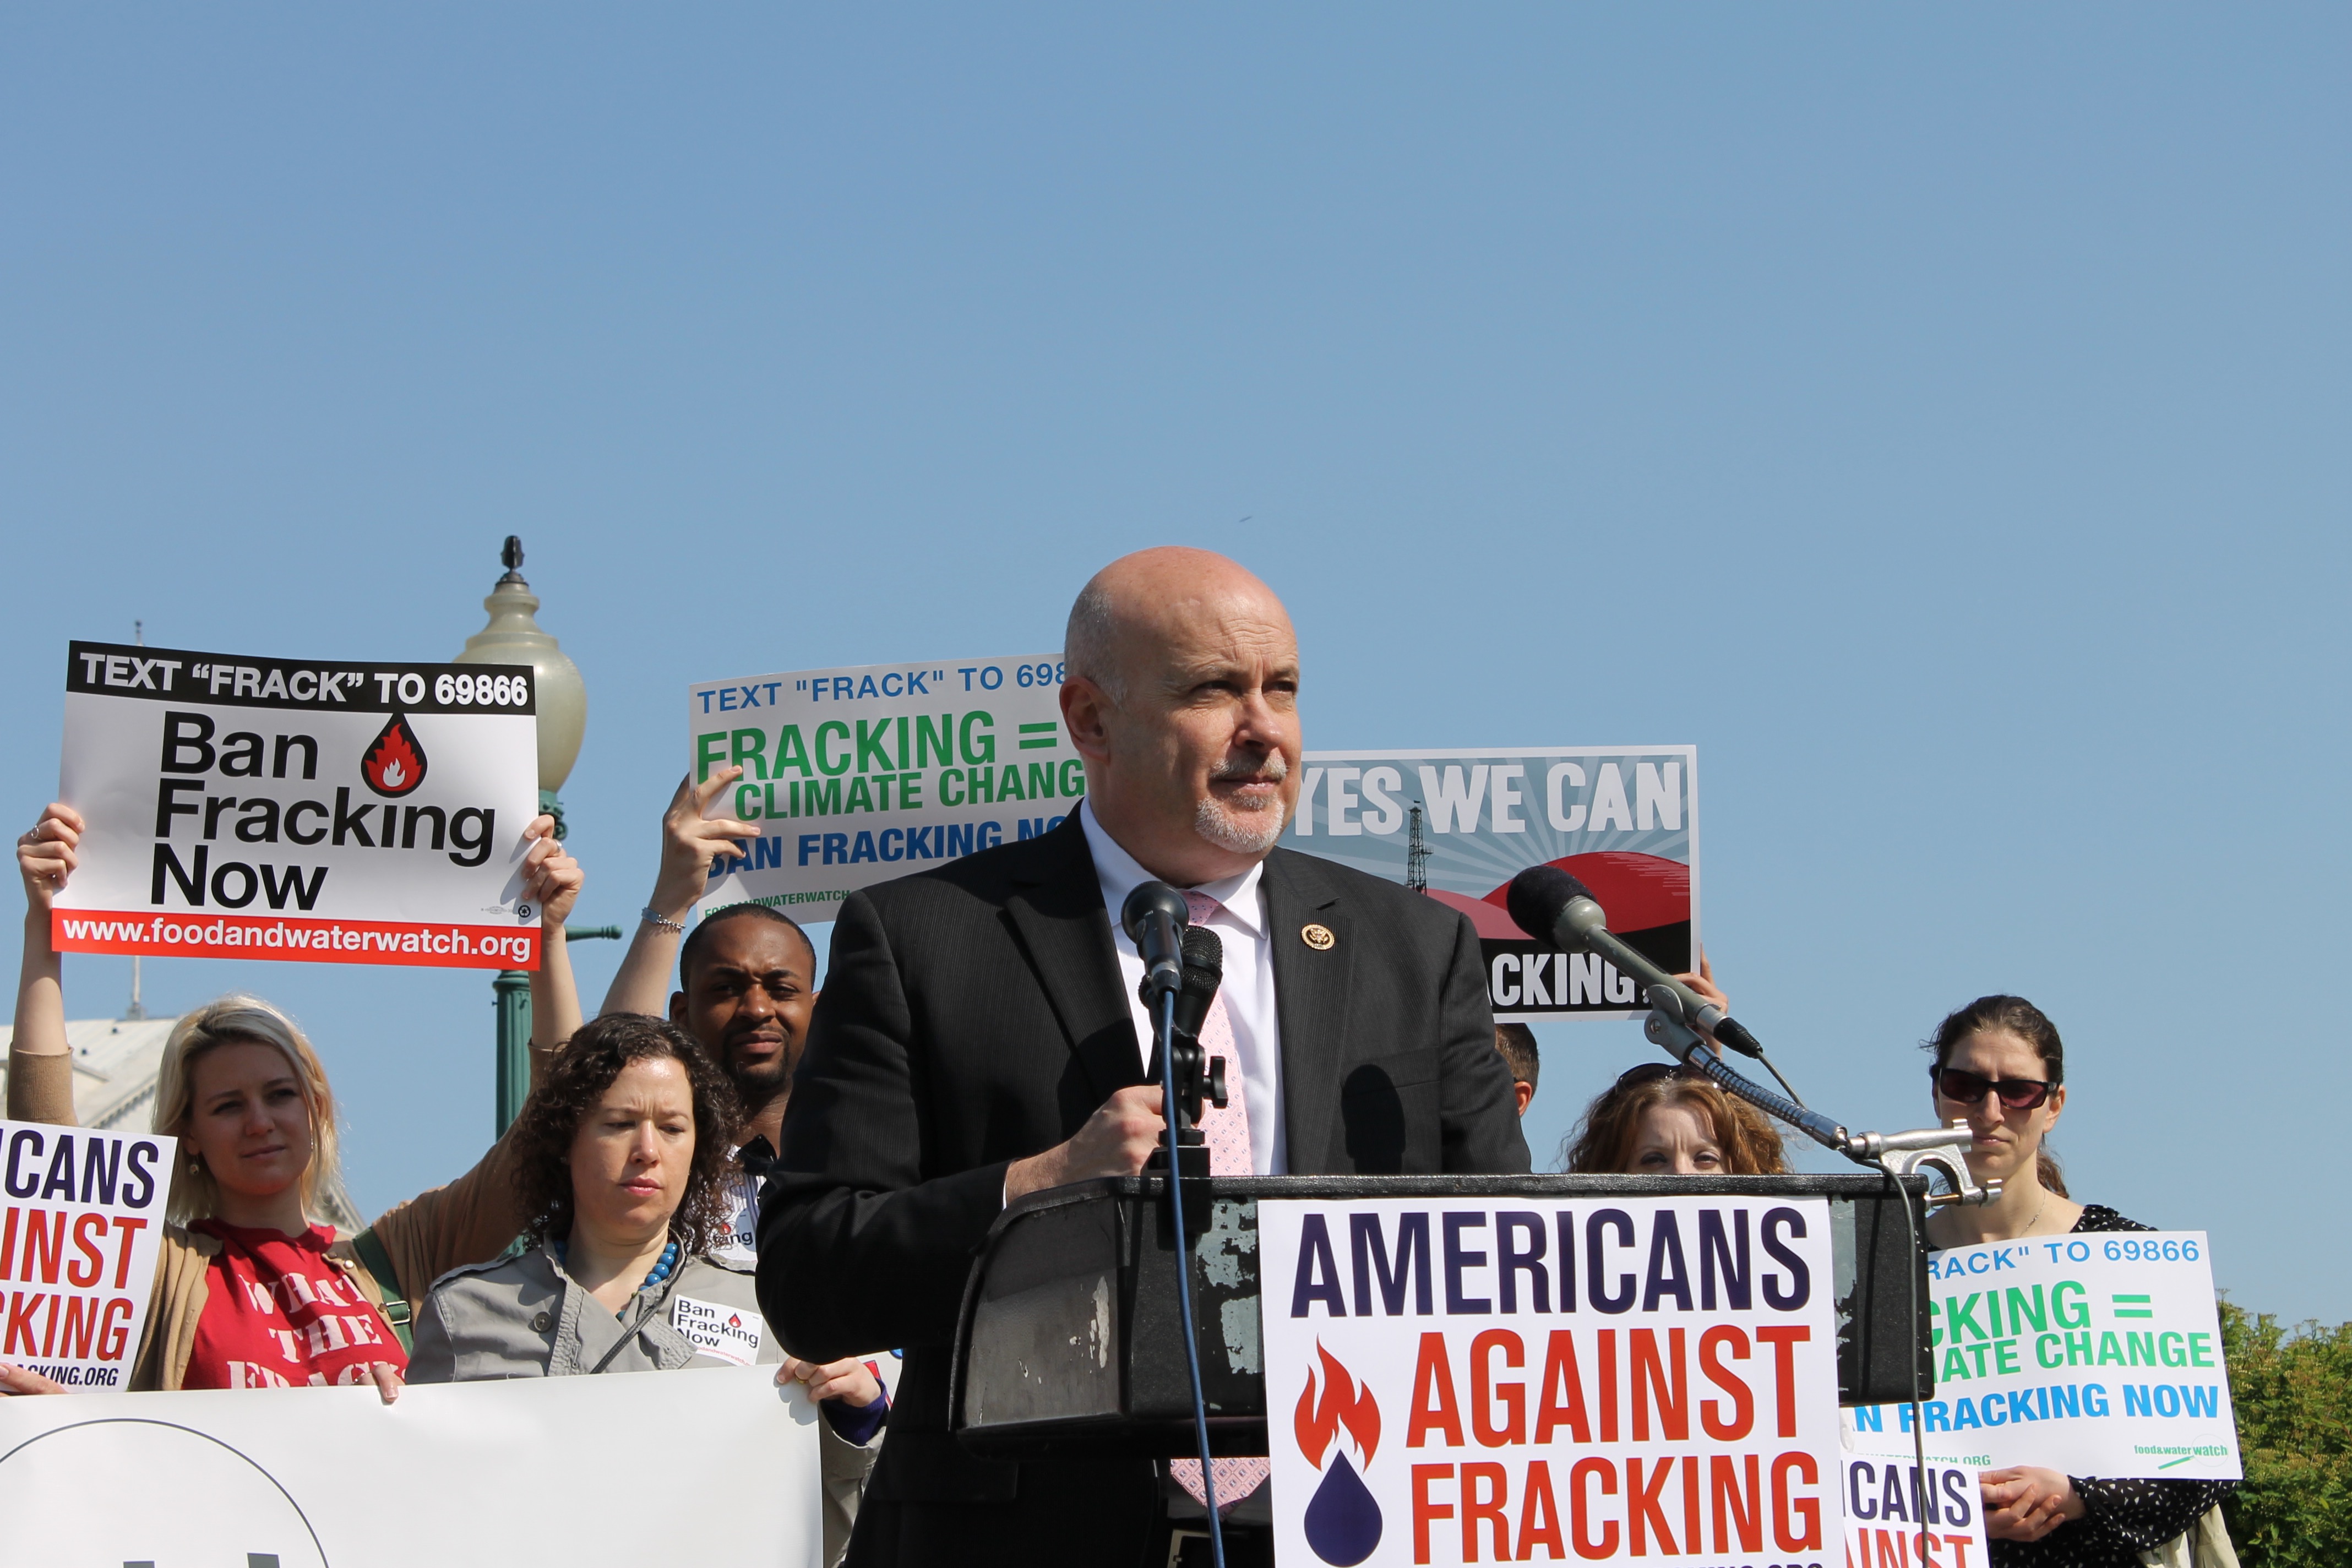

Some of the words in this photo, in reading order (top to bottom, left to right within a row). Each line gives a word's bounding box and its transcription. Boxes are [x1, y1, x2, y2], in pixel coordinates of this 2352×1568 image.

[79, 652, 182, 692] TEXT
[374, 672, 426, 705] TO
[434, 674, 529, 707] 69866
[697, 682, 782, 714] TEXT
[796, 669, 943, 702] "FRACK"
[957, 666, 1004, 692] TO
[160, 710, 319, 780] Ban
[698, 710, 995, 785] FRACKING
[1019, 722, 1057, 750] =
[155, 777, 495, 867] Fracking
[735, 772, 923, 821] CLIMATE
[1295, 766, 1403, 836] YES
[1418, 765, 1526, 834] WE
[1547, 761, 1682, 833] CAN
[798, 821, 1002, 867] FRACKING
[150, 842, 329, 911] Now
[62, 918, 531, 963] www.foodandwaterwatch.org
[0, 1128, 159, 1208] CANS
[0, 1206, 148, 1289] INST
[1290, 1206, 1811, 1319] AMERICANS
[2043, 1241, 2090, 1264] TO
[2103, 1240, 2200, 1262] 69866
[238, 1272, 368, 1315] WHAT
[678, 1299, 715, 1319] Ban
[2111, 1294, 2153, 1319] =
[268, 1314, 383, 1363] THE
[677, 1314, 759, 1349] Fracking
[1932, 1338, 2021, 1384] ATE
[2035, 1331, 2215, 1369] CHANGE
[1405, 1324, 1811, 1448] AGAINST
[1852, 1403, 1883, 1433] N
[1897, 1383, 2110, 1433] FRACKING
[2122, 1384, 2219, 1419] NOW
[1410, 1451, 1822, 1565] FRACKING
[1841, 1459, 1971, 1528] CANS
[1844, 1526, 1973, 1568] INST
